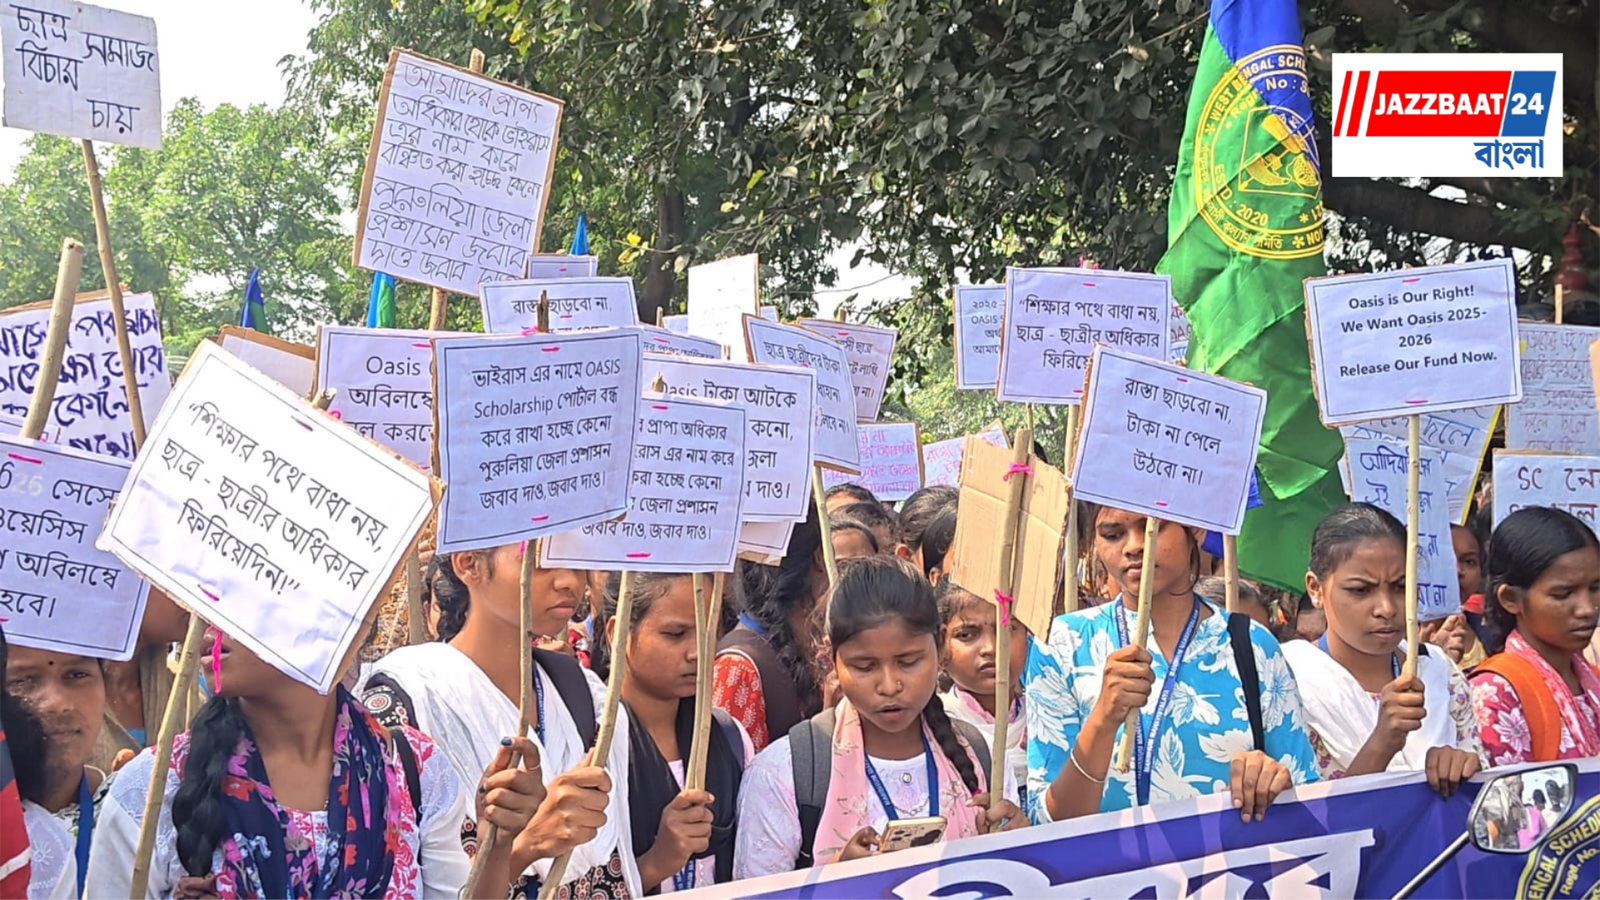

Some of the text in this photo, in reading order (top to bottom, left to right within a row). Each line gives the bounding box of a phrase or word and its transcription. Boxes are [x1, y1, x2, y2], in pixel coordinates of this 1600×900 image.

[9, 4, 155, 72] ছাত্র সমাজ
[404, 63, 493, 108] আমাদের
[86, 99, 141, 134] চায়
[391, 93, 463, 131] অধিকার
[1210, 87, 1235, 121] WEST
[387, 118, 523, 172] এর নাম করে
[506, 176, 542, 200] কেনো
[482, 206, 536, 244] জেলা
[1235, 203, 1269, 227] 2020
[419, 252, 473, 281] জবাব
[462, 235, 529, 269] জবাব
[1018, 294, 1071, 317] “শিক্ষার
[1075, 302, 1104, 318] পথে
[1107, 304, 1135, 320] বাধা
[1137, 306, 1161, 324] নয়,
[1349, 285, 1475, 309] Oasis is Our Right!
[971, 315, 998, 325] OASIS
[1341, 307, 1487, 333] We Want Oasis 2025-
[1016, 324, 1045, 343] ছাত্র
[1105, 328, 1160, 348] অধিকার
[1399, 333, 1433, 348] 2026
[366, 355, 422, 376] Oasis
[472, 359, 621, 387] ভাইরাস এর নামে OASIS
[1339, 350, 1498, 377] Release Our Fund Now.
[474, 395, 553, 419] Scholarship
[600, 385, 619, 403] বন্ধ
[743, 385, 798, 408] আটকে
[1125, 377, 1232, 425] রাস্তা ছাড়বো না,
[480, 415, 612, 448] করে রাখা হচ্ছে কেনো
[648, 418, 727, 440] প্রাপ্য অধিকার
[1127, 410, 1221, 454] টাকা না পেলে
[479, 442, 612, 482] পুরুলিয়া জেলা প্রশাসন
[664, 447, 682, 462] এর
[686, 449, 708, 464] নাম
[711, 451, 735, 467] করে
[1133, 449, 1203, 485] উঠবো না।
[189, 401, 259, 463] “শিক্ষার
[262, 450, 306, 493] পথে
[306, 477, 351, 522] বাধা
[351, 506, 389, 553] নয়,
[480, 470, 606, 510] জবাব দাও, জবাব দাও।
[656, 471, 685, 488] হচ্ছে
[688, 474, 722, 490] কেনো
[756, 480, 790, 499] দাও।
[1517, 466, 1544, 491] SC
[161, 438, 205, 481] ছাত্র
[217, 474, 282, 532] ছাত্রীর
[282, 516, 369, 591] অধিকার
[640, 497, 718, 516] জেলা প্রশাসন
[622, 522, 646, 540] দাও,
[650, 524, 683, 540] জবাব
[686, 525, 711, 541] দাও।
[16, 550, 121, 590] অবিলম্বে
[1528, 854, 1559, 900] ENGAL
